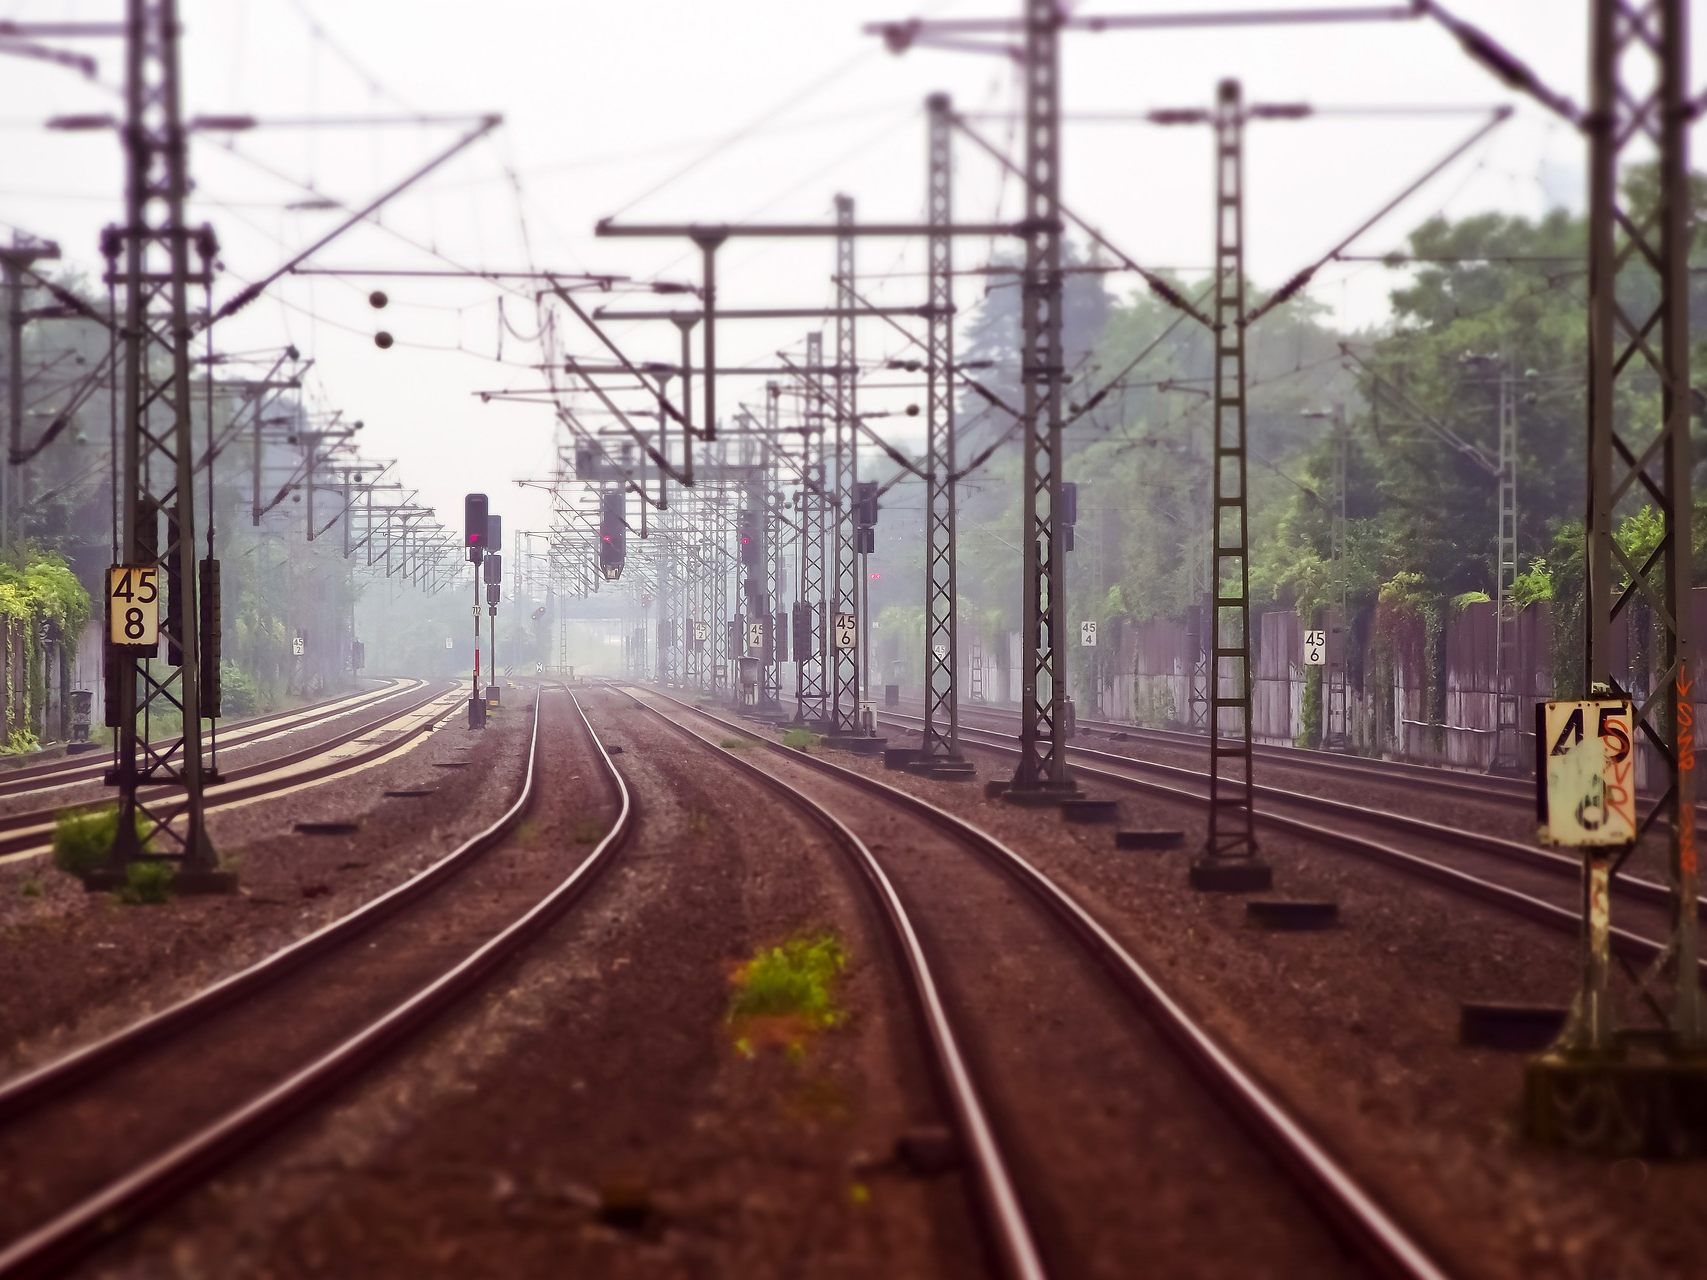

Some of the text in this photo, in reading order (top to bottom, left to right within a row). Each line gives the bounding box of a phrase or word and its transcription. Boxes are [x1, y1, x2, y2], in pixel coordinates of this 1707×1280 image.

[112, 569, 157, 603] 45
[124, 607, 145, 639] 8
[837, 616, 855, 629] 45
[1082, 623, 1096, 633] 45
[751, 625, 763, 635] 45
[294, 638, 304, 646] 45
[753, 636, 760, 645] 4
[842, 631, 850, 644] 6
[1086, 635, 1092, 644] 4
[1306, 632, 1325, 646] 45
[296, 646, 301, 654] 2
[1310, 648, 1319, 662] 6
